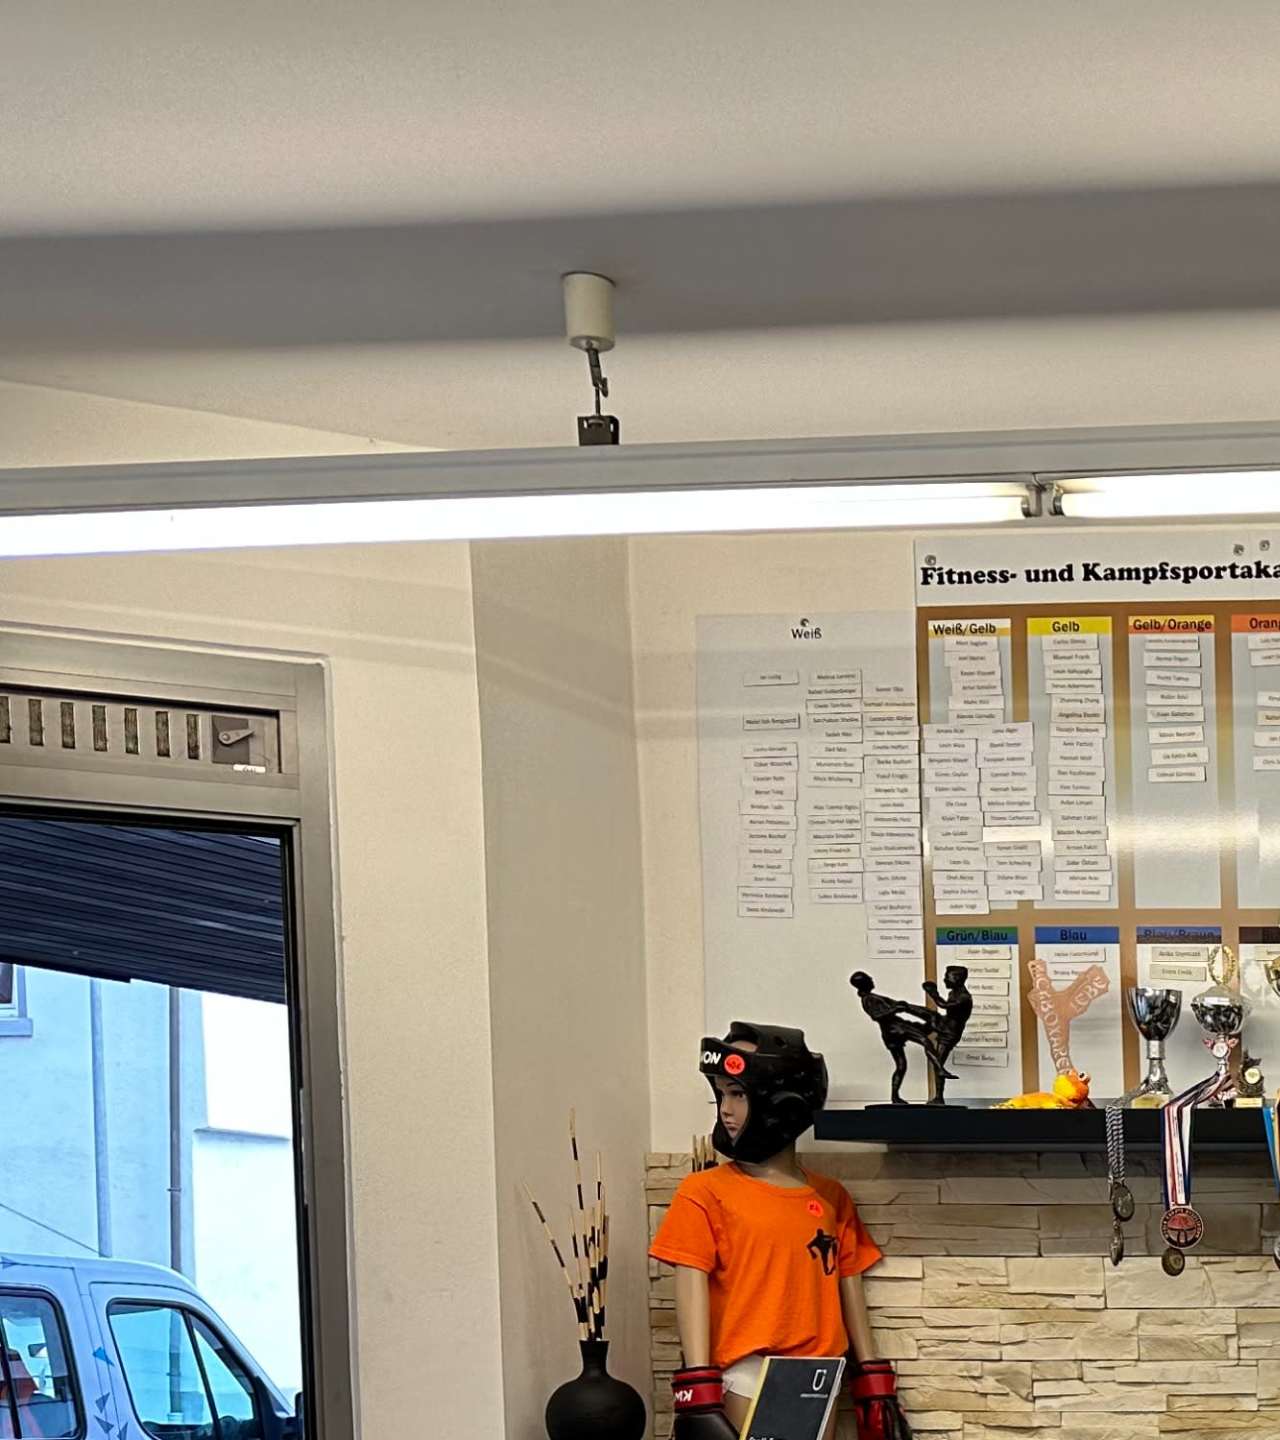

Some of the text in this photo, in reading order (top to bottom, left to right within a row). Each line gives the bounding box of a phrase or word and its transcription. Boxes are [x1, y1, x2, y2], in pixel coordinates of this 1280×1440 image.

[920, 566, 1017, 585] Fitness-
[1026, 563, 1074, 583] und
[932, 622, 996, 635] Weiß/Gelb
[1051, 620, 1080, 633] Gelb
[1132, 618, 1212, 633] Gelb/Orange
[791, 627, 822, 640] Weiß
[946, 929, 1008, 942] Grün/Blau
[1060, 929, 1087, 941] Blau
